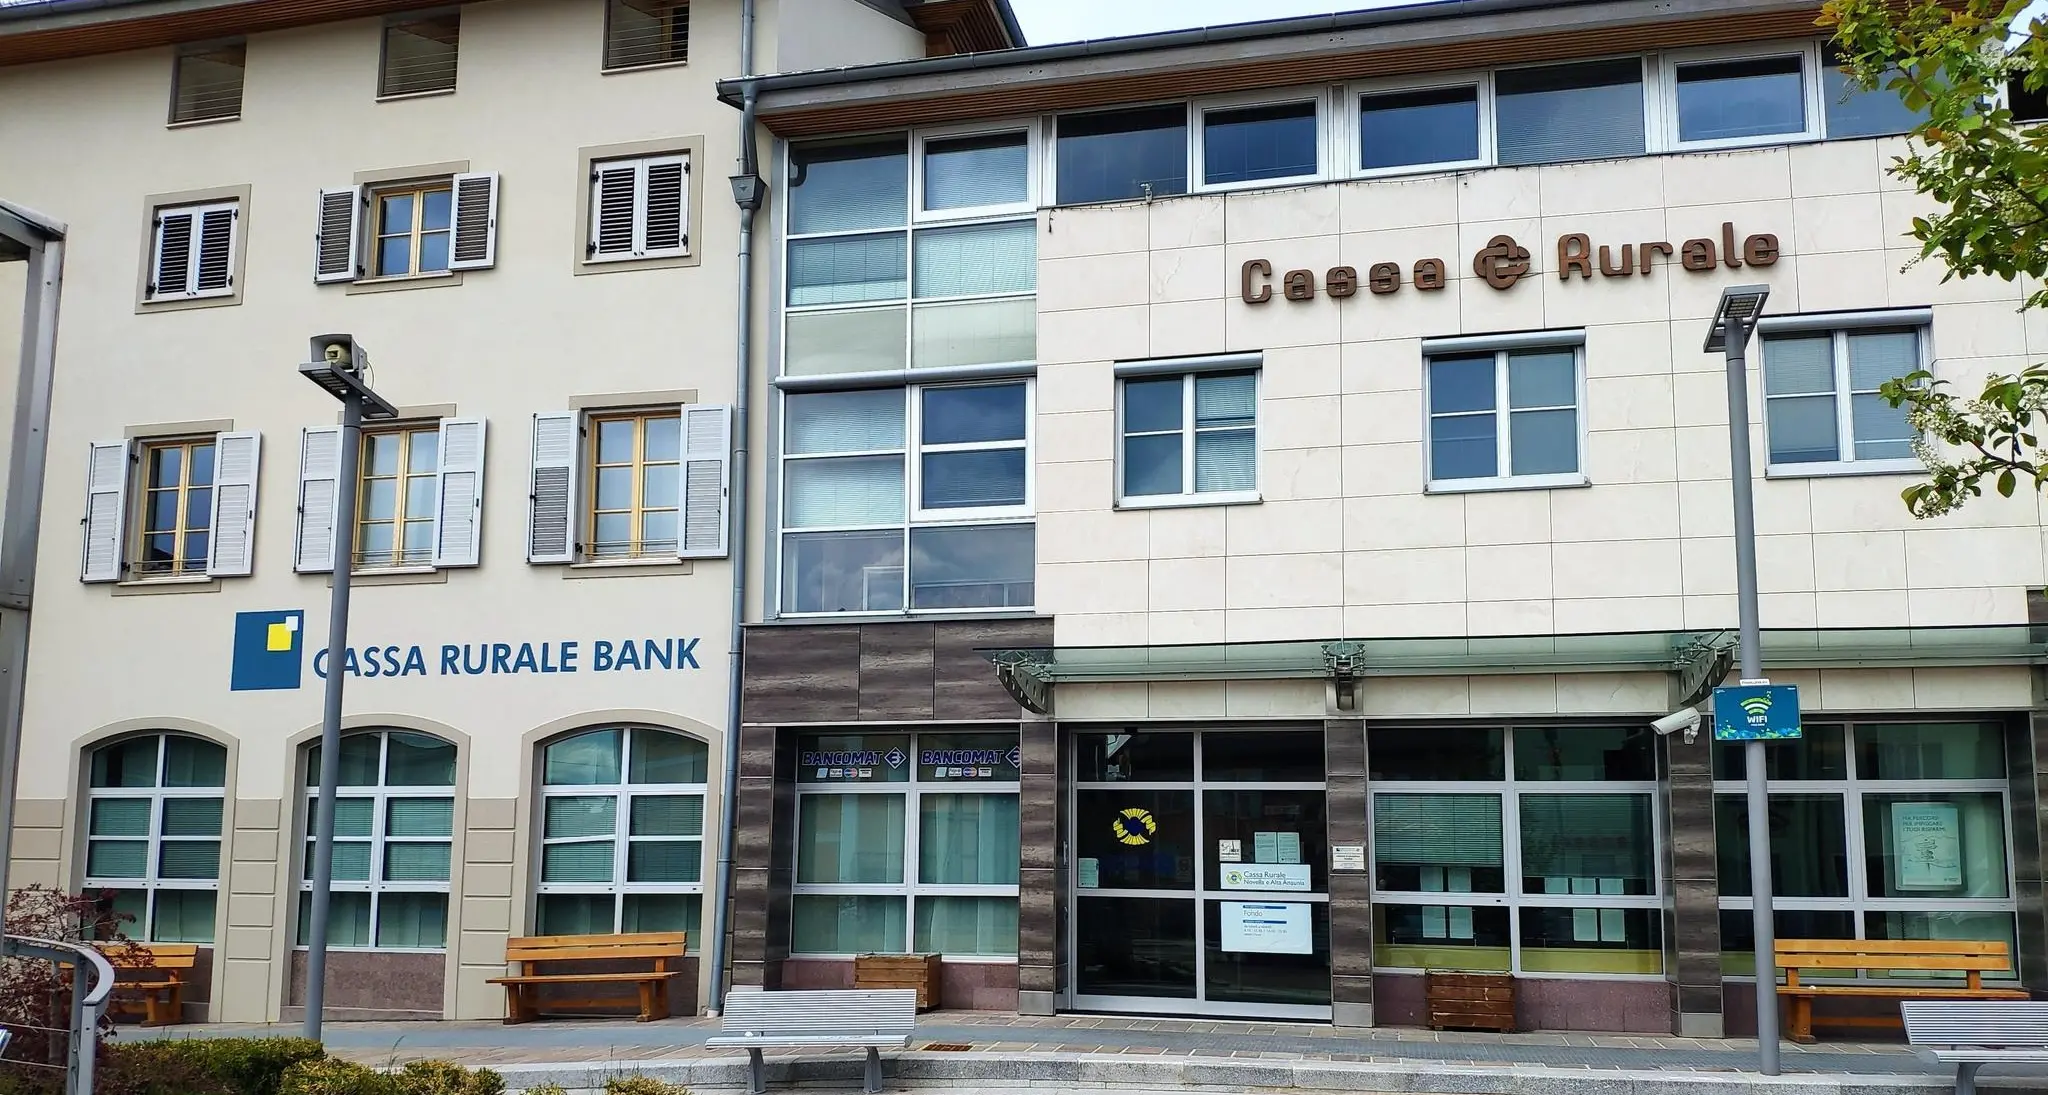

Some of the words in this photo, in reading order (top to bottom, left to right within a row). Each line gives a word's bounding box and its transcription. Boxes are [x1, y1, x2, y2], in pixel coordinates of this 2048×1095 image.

[1241, 257, 1446, 304] Cassa
[1557, 221, 1781, 280] Rurale
[440, 641, 579, 676] RURALE
[593, 637, 701, 672] BANK
[1746, 715, 1768, 723] WIFI
[801, 751, 884, 766] BANCOMAT
[920, 749, 1005, 765] BANCOMAT
[1243, 870, 1263, 878] Cassa
[1243, 909, 1263, 917] Fondo
